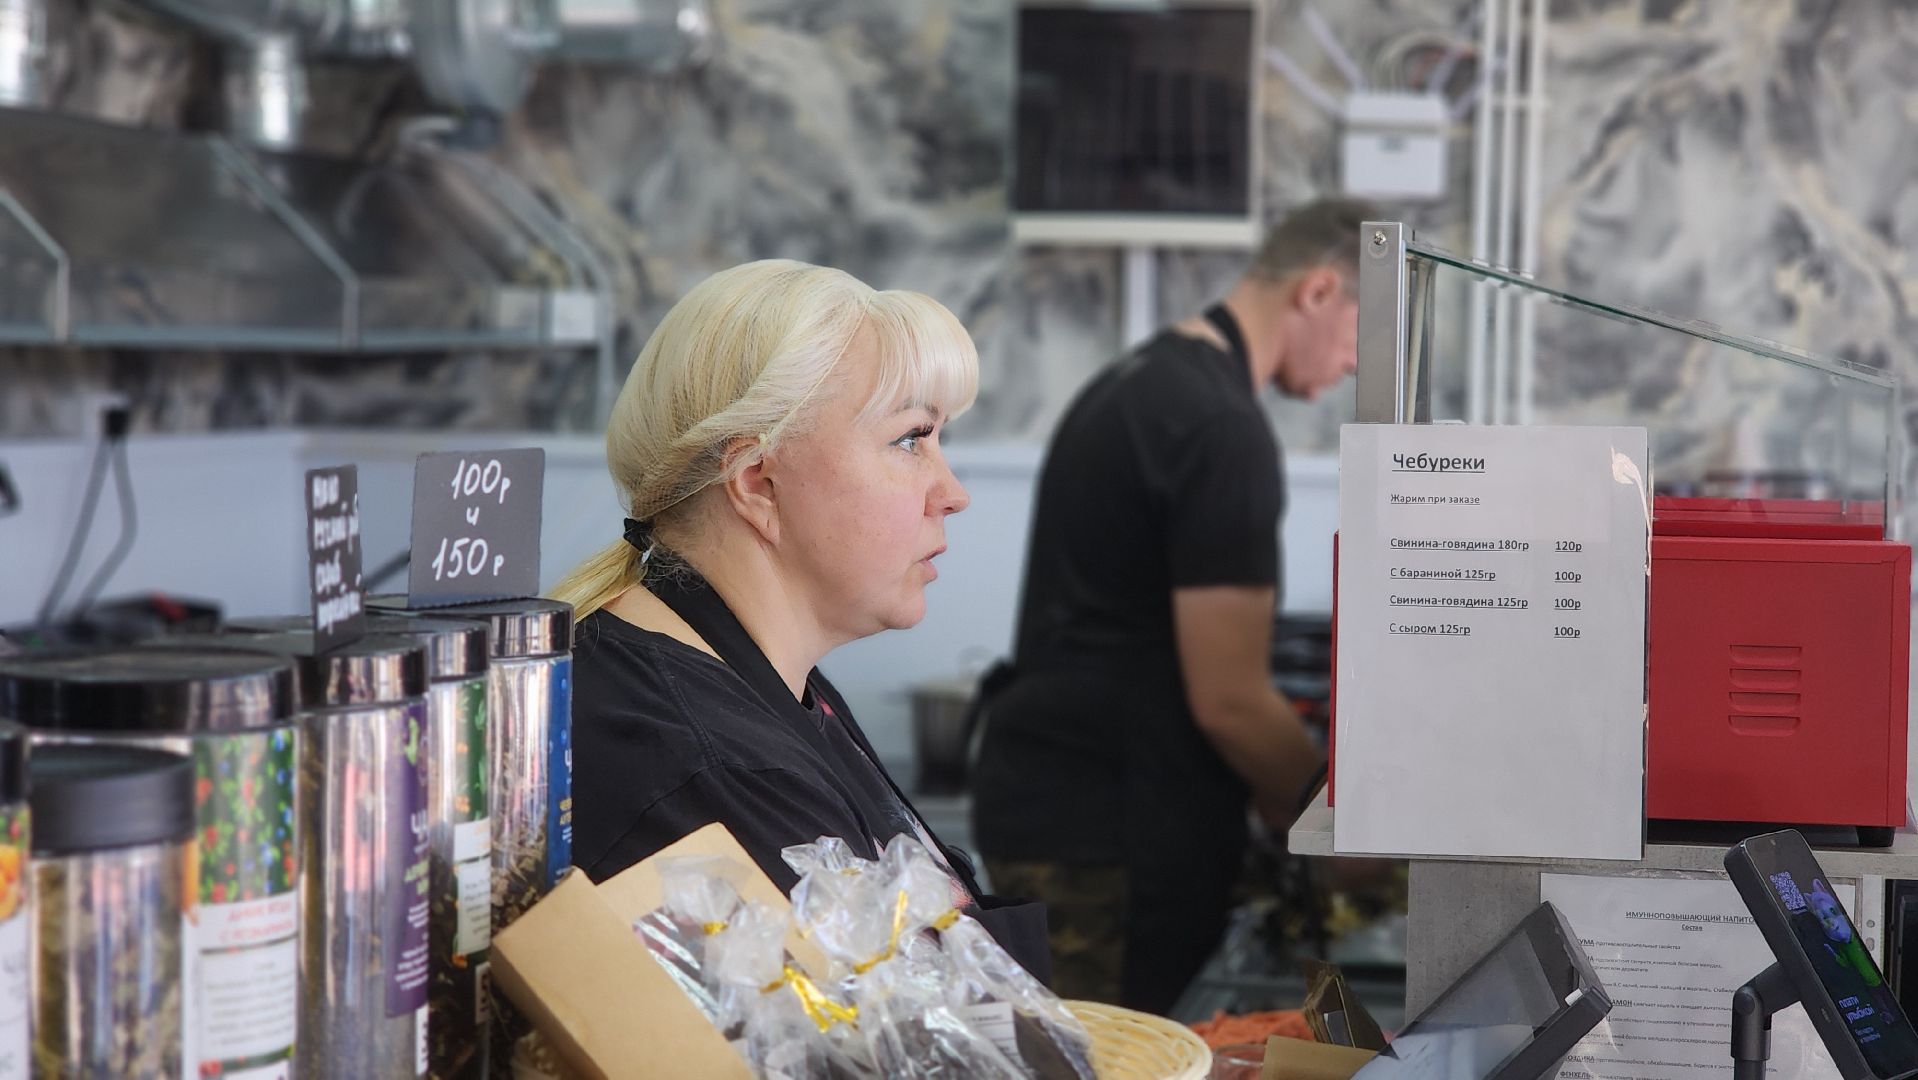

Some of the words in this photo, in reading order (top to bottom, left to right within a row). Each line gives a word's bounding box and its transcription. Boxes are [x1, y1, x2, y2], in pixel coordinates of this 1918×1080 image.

[1392, 453, 1485, 472] Чебуреки
[451, 459, 512, 504] 100р
[1390, 494, 1426, 504] Жарим
[1427, 495, 1447, 505] при
[1448, 496, 1480, 504] заказе
[466, 507, 480, 525] и
[1390, 538, 1495, 550] Свинина-говядина
[1498, 539, 1529, 552] 180гр
[1555, 540, 1582, 553] 120р
[1390, 568, 1398, 579] С
[1400, 568, 1462, 580] бараниной
[1465, 569, 1496, 581] 125гр
[1554, 571, 1582, 583] 100р
[1389, 595, 1494, 608] Свинина-говядина
[1497, 596, 1529, 609] 125гр
[1554, 598, 1581, 610] 100р
[1389, 622, 1397, 634] С
[1399, 624, 1437, 636] сыром
[1439, 623, 1471, 636] 125гр
[1554, 626, 1581, 639] 100р
[1723, 915, 1755, 924] НАПИТО
[1577, 938, 1594, 946] УМА
[1611, 999, 1633, 1007] АМОН
